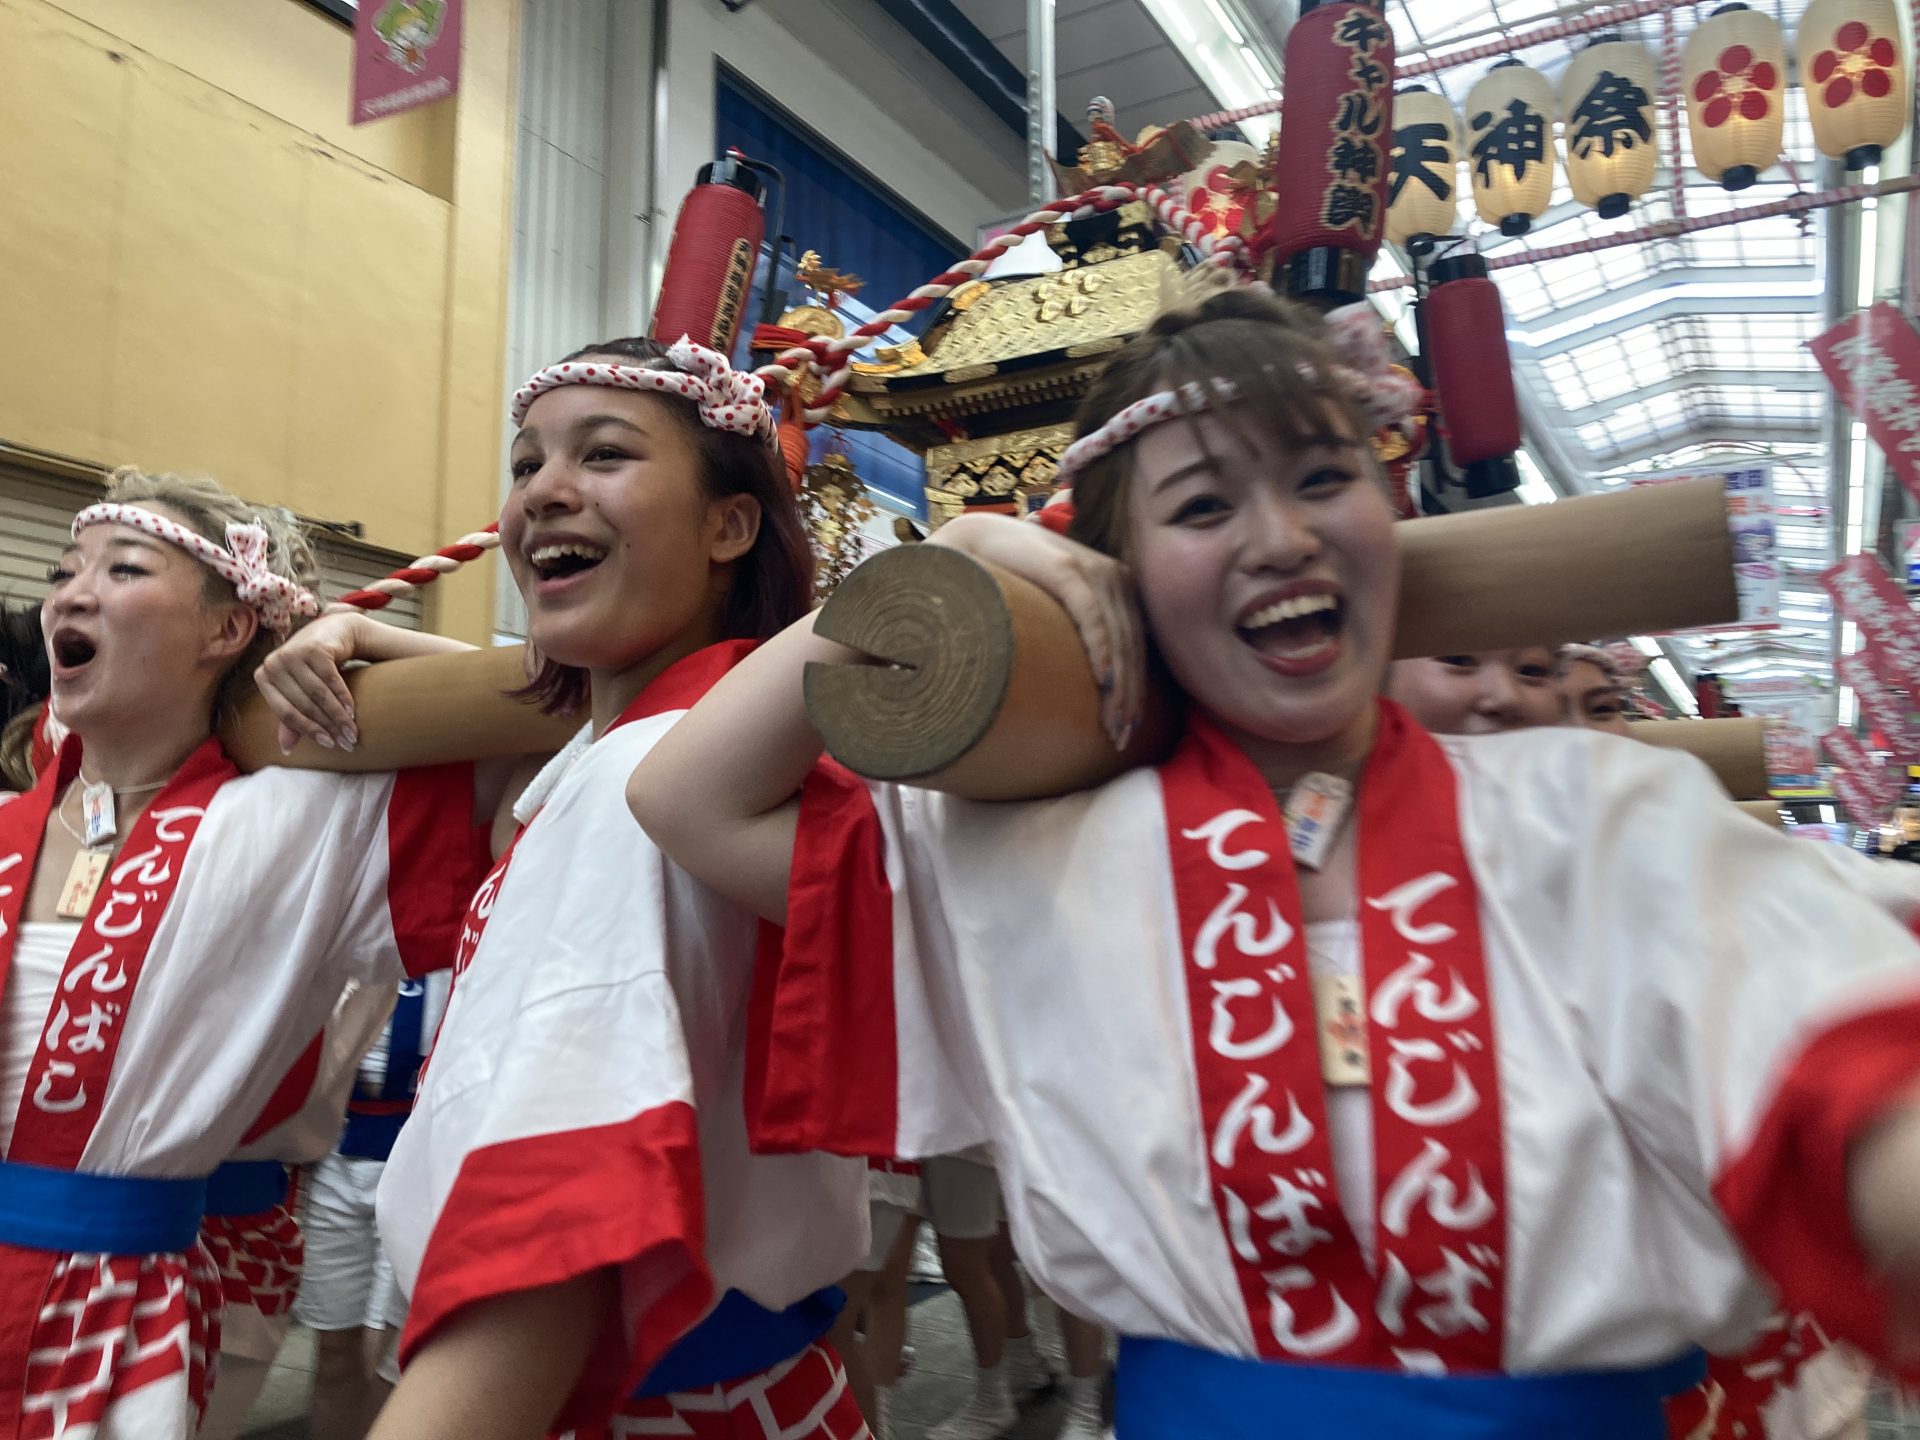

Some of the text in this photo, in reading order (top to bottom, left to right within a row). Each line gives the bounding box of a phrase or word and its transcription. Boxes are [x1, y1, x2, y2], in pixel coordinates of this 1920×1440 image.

[33, 805, 205, 1113] てんじんばし
[1182, 808, 1360, 1357] てんじんばし
